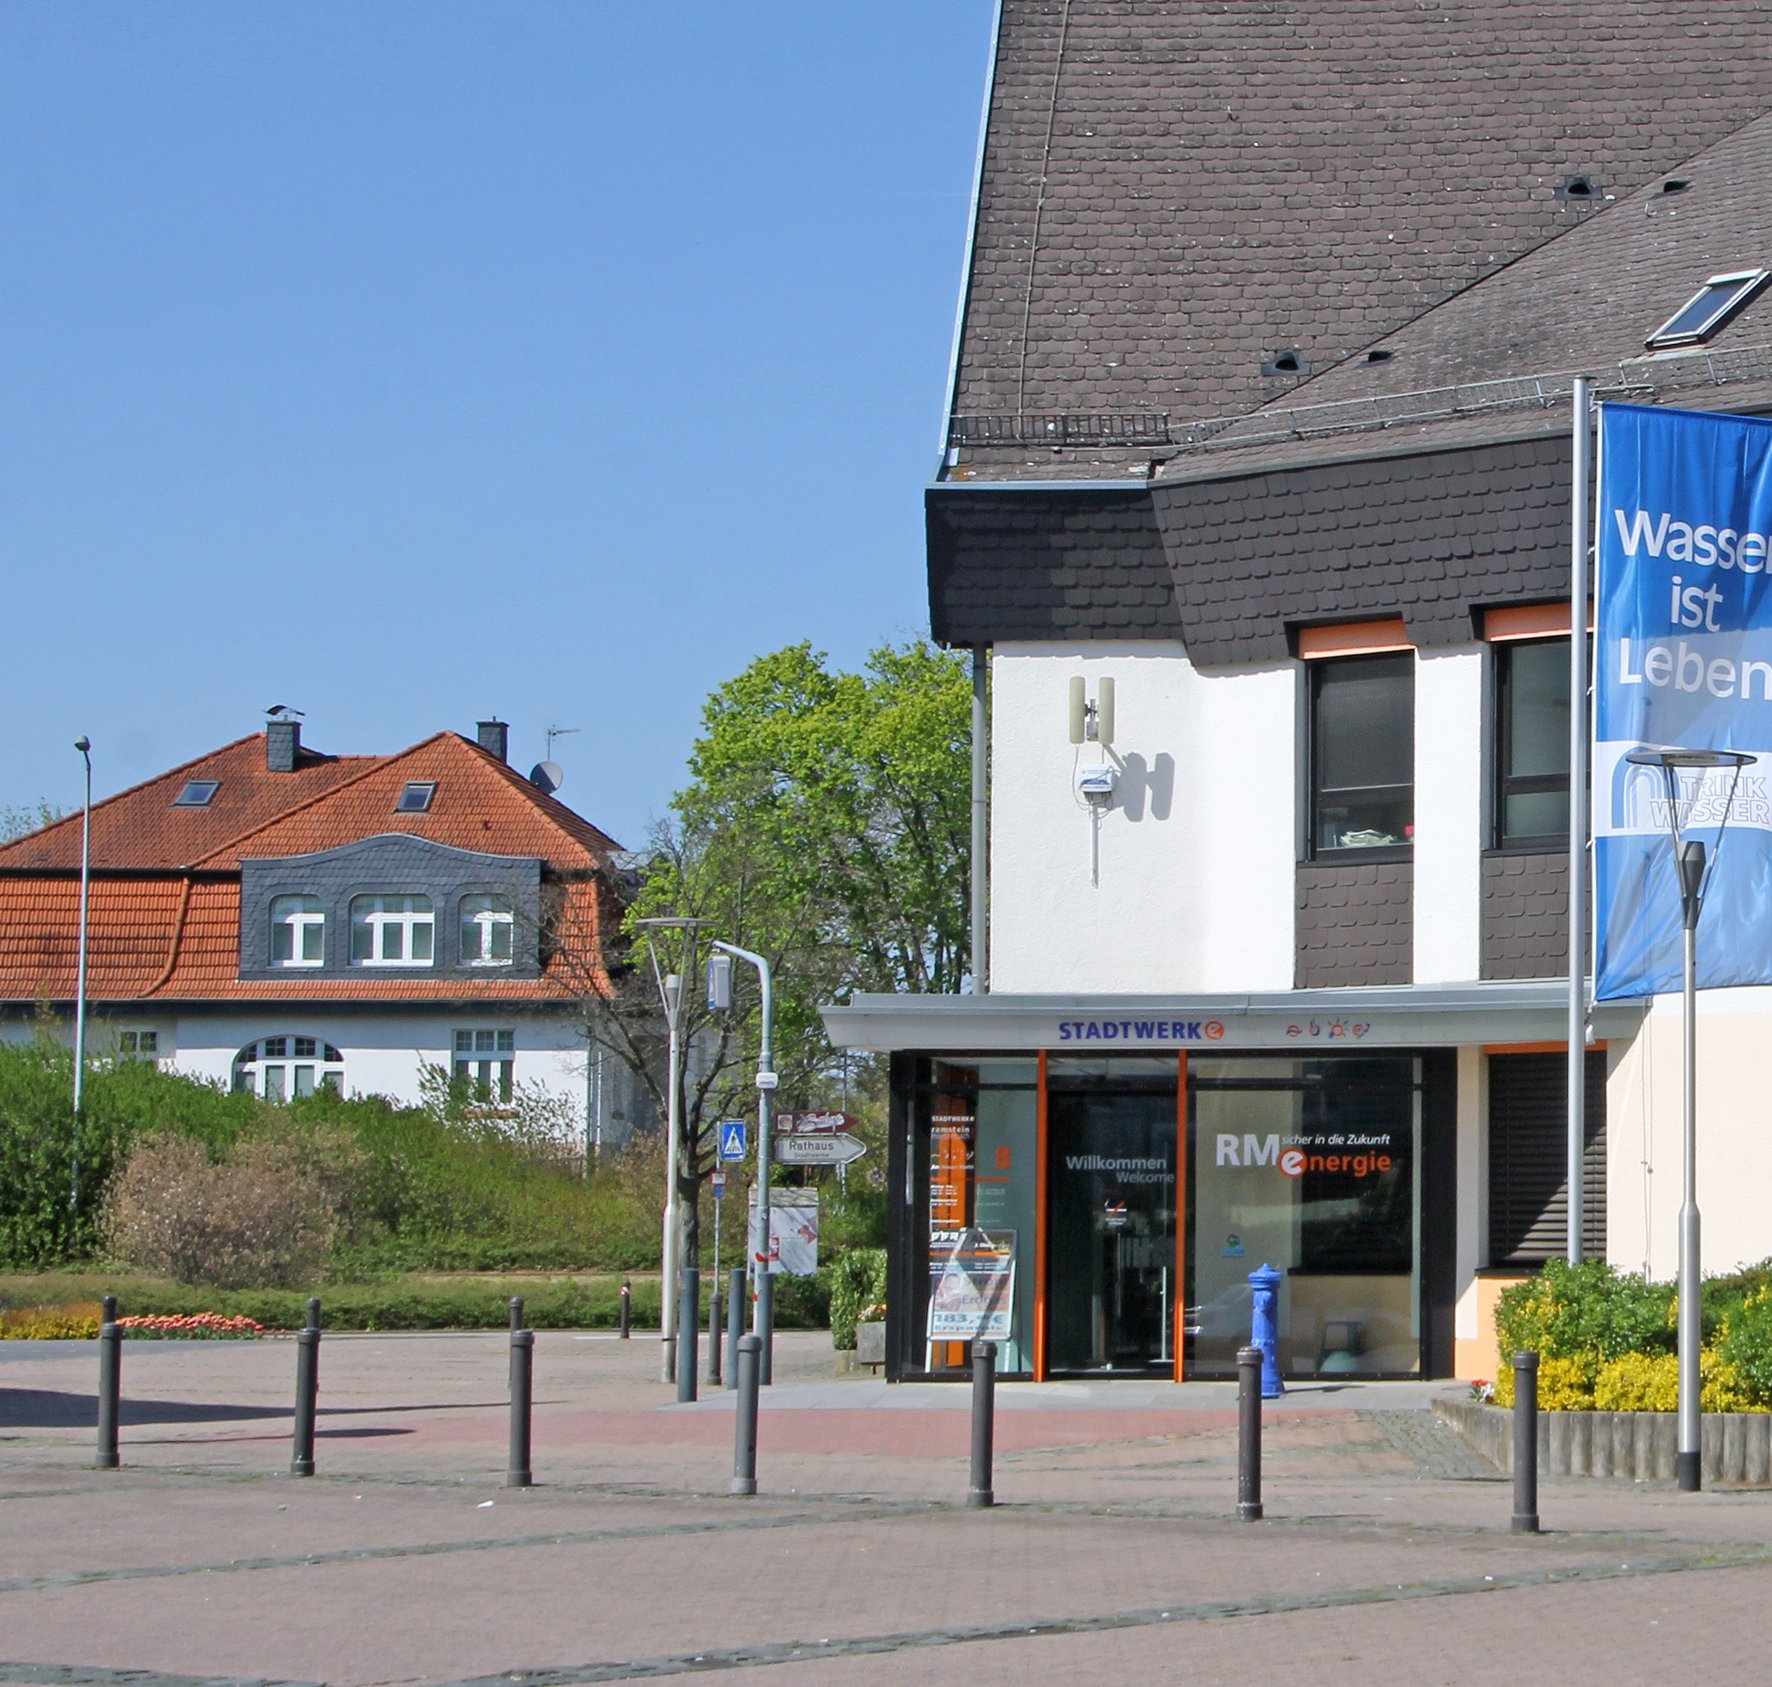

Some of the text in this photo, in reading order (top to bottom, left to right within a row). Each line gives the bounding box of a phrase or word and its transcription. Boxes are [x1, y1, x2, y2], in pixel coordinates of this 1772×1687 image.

[1670, 575, 1724, 632] ist
[1680, 775, 1768, 800] TRINK
[1281, 1133, 1391, 1145] sicher in die Zukunft
[789, 1141, 834, 1151] Rathaus
[1065, 1155, 1168, 1170] Willkommen
[1116, 1171, 1175, 1183] Welcome
